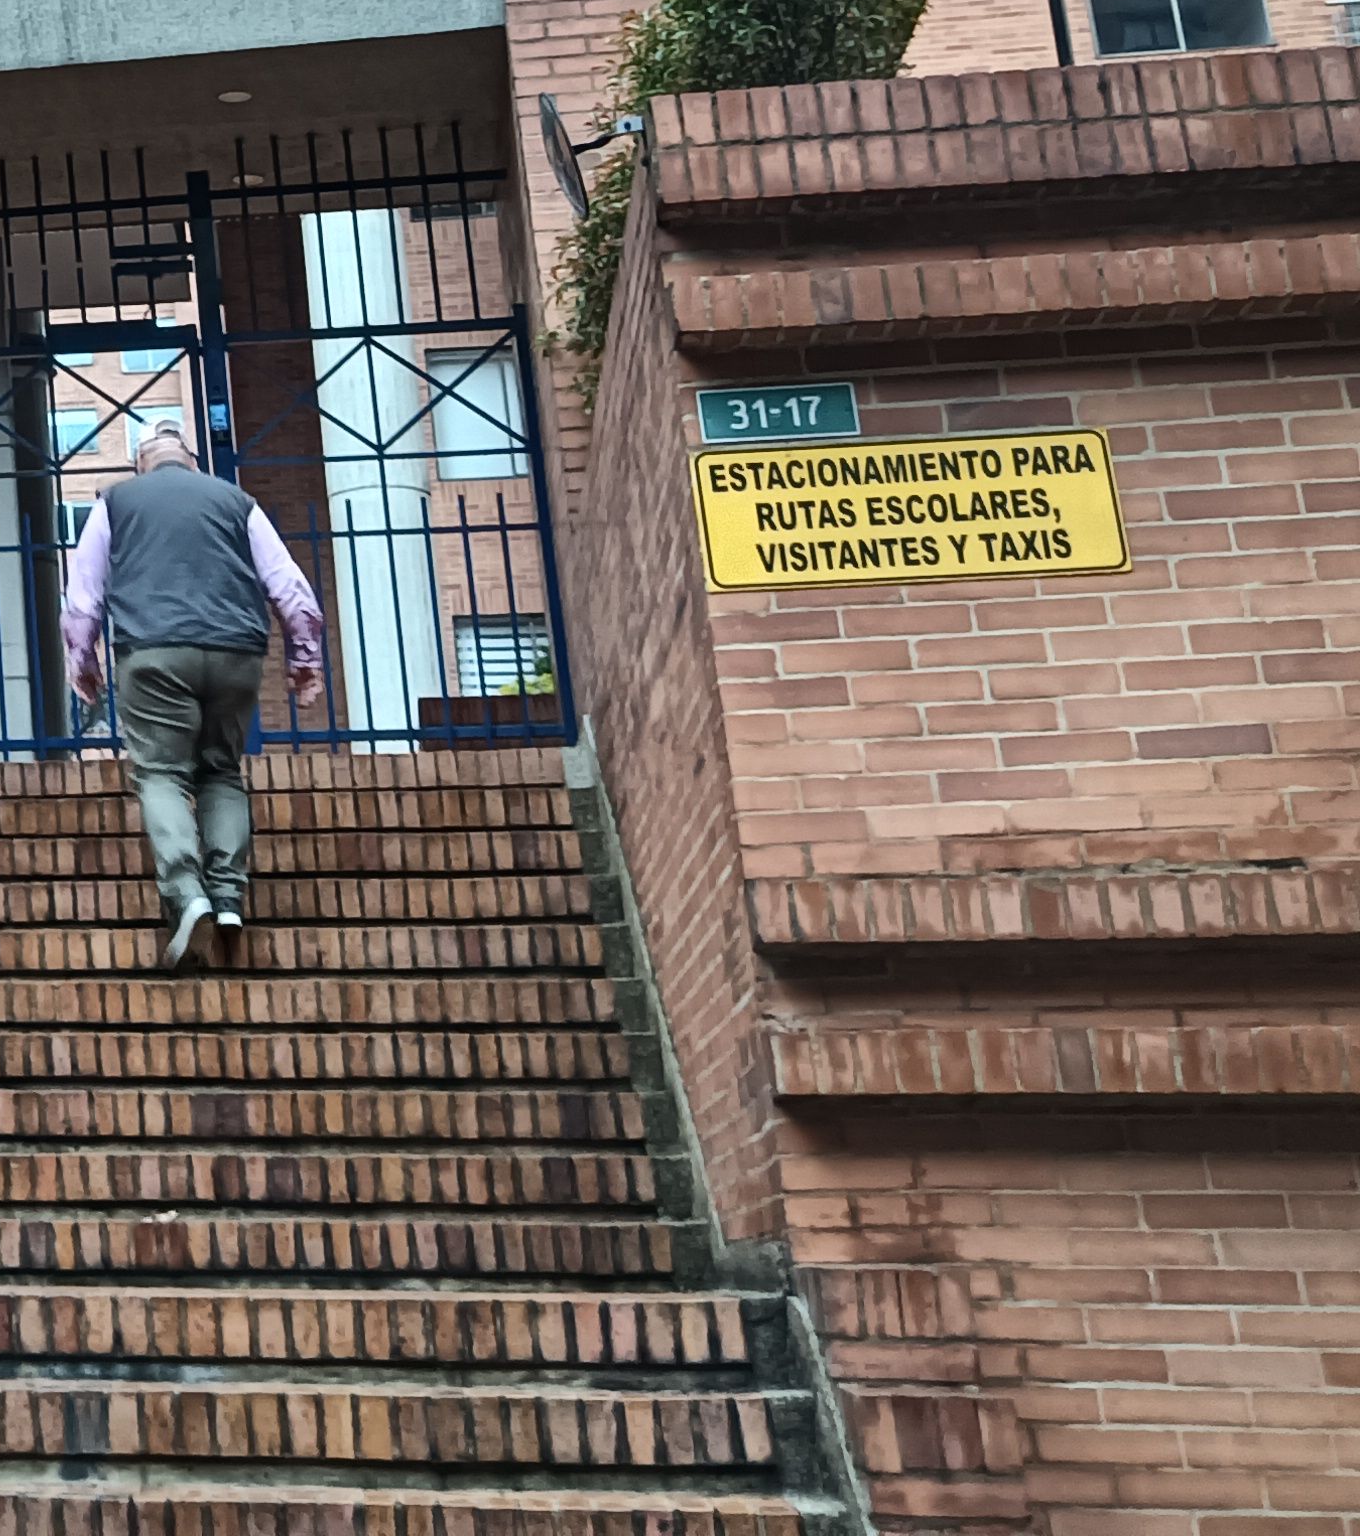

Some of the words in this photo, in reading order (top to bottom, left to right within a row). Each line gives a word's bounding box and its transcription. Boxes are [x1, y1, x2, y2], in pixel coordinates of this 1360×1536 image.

[727, 395, 822, 431] 31-17
[707, 449, 1003, 493] ESTACIONAMIENTO
[1012, 443, 1097, 478] PARA
[754, 497, 858, 532] RUTAS
[865, 487, 1062, 527] ESCOLARES,
[754, 536, 941, 574] VISITANTES
[947, 534, 969, 564] Y
[978, 528, 1073, 563] TAXIS
